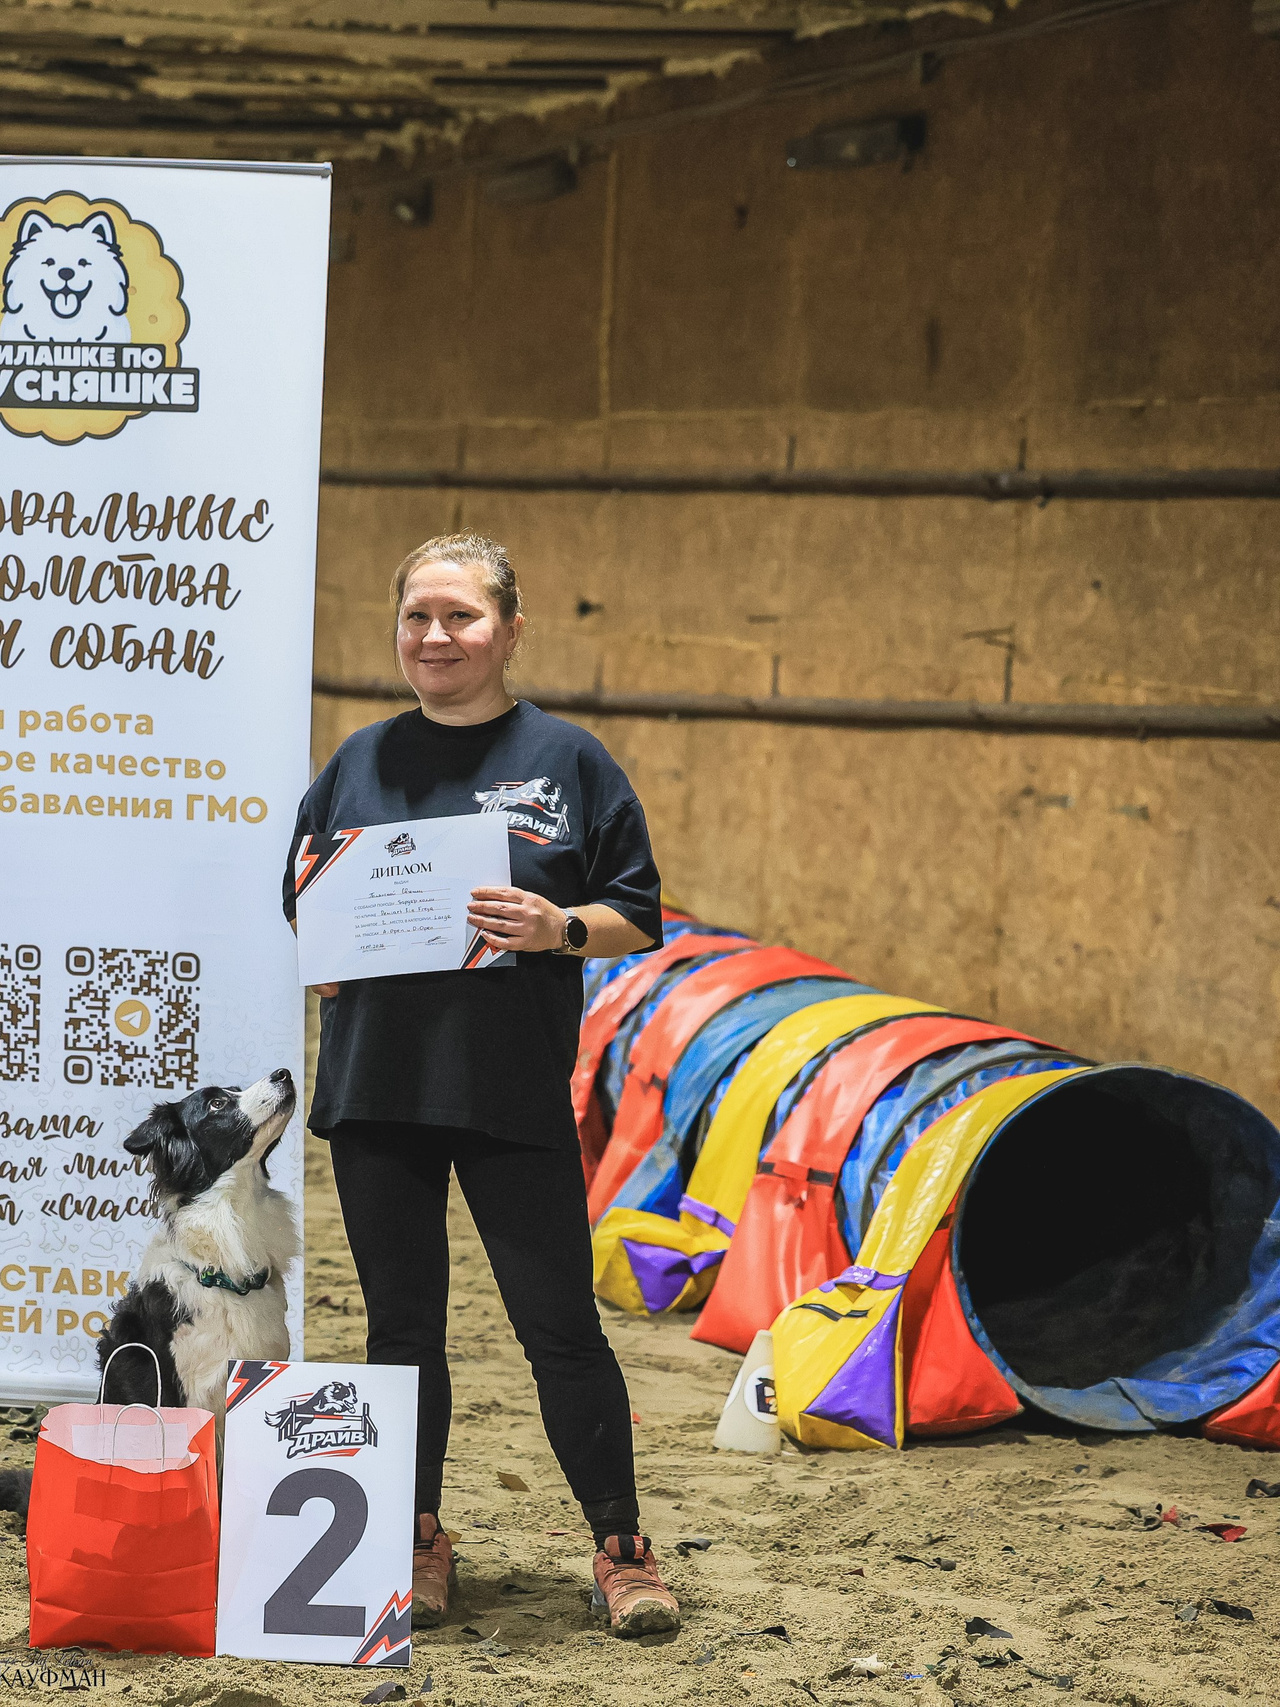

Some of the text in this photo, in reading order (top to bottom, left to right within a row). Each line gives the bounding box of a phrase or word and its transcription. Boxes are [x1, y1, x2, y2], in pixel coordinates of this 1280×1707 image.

[121, 346, 163, 370] ПО
[50, 622, 225, 680] СОБАК
[18, 704, 154, 739] работа
[50, 752, 227, 781] качество
[186, 793, 269, 824] ГМО
[369, 861, 433, 880] ДИПЛОМ
[263, 1467, 369, 1638] 2
